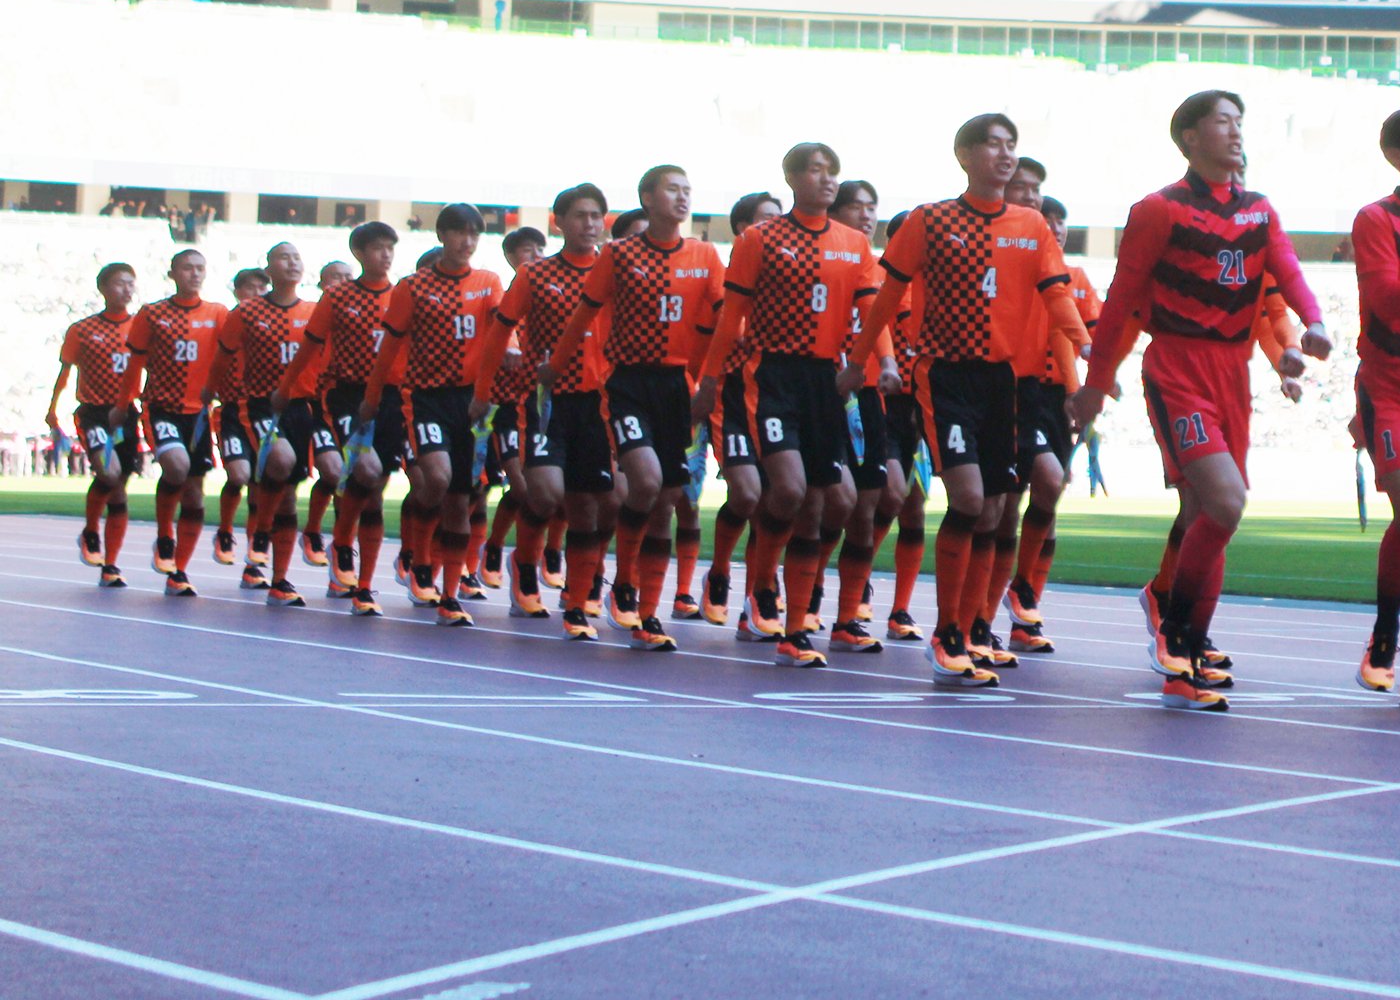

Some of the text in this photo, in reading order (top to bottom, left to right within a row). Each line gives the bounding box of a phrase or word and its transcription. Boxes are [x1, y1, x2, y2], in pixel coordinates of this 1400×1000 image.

[1217, 249, 1248, 285] 21
[982, 267, 997, 298] 4
[659, 295, 684, 323] 13
[811, 283, 828, 313] 8
[453, 314, 476, 340] 19
[174, 340, 198, 362] 28
[87, 426, 108, 448] 20
[338, 415, 352, 436] 7
[417, 422, 443, 446] 19
[615, 415, 643, 445] 13
[764, 417, 784, 443] 8
[1174, 412, 1209, 451] 21
[223, 436, 243, 456] 18
[313, 430, 335, 449] 12
[533, 434, 549, 457] 2
[727, 434, 750, 457] 11
[947, 424, 966, 454] 4
[1381, 429, 1397, 461] 1
